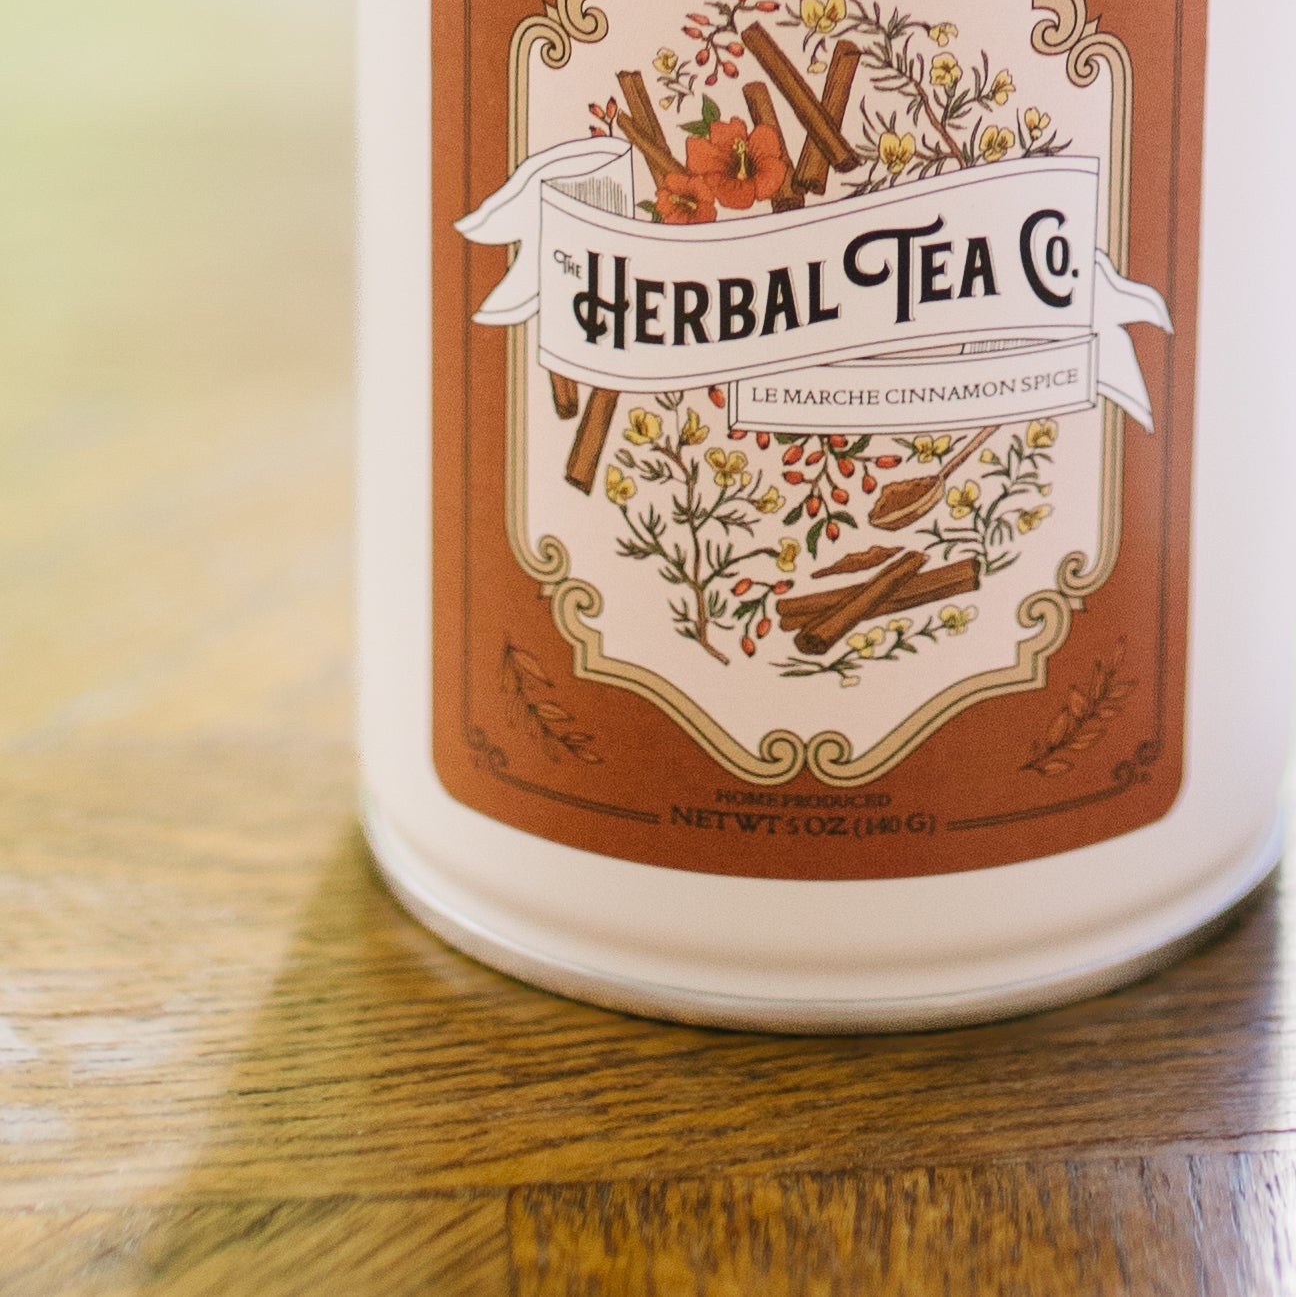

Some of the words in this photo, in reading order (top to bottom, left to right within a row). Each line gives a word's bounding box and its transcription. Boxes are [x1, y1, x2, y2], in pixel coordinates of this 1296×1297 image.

[572, 249, 841, 350] HERBAL
[843, 213, 1000, 324] TEA
[752, 386, 778, 403] LE
[783, 388, 880, 405] MARCHE
[885, 378, 1016, 405] CINNAMON
[1021, 368, 1079, 393] SPICE
[782, 793, 892, 808] PRODUCED
[671, 805, 728, 831] NET
[803, 815, 848, 836] OZ
